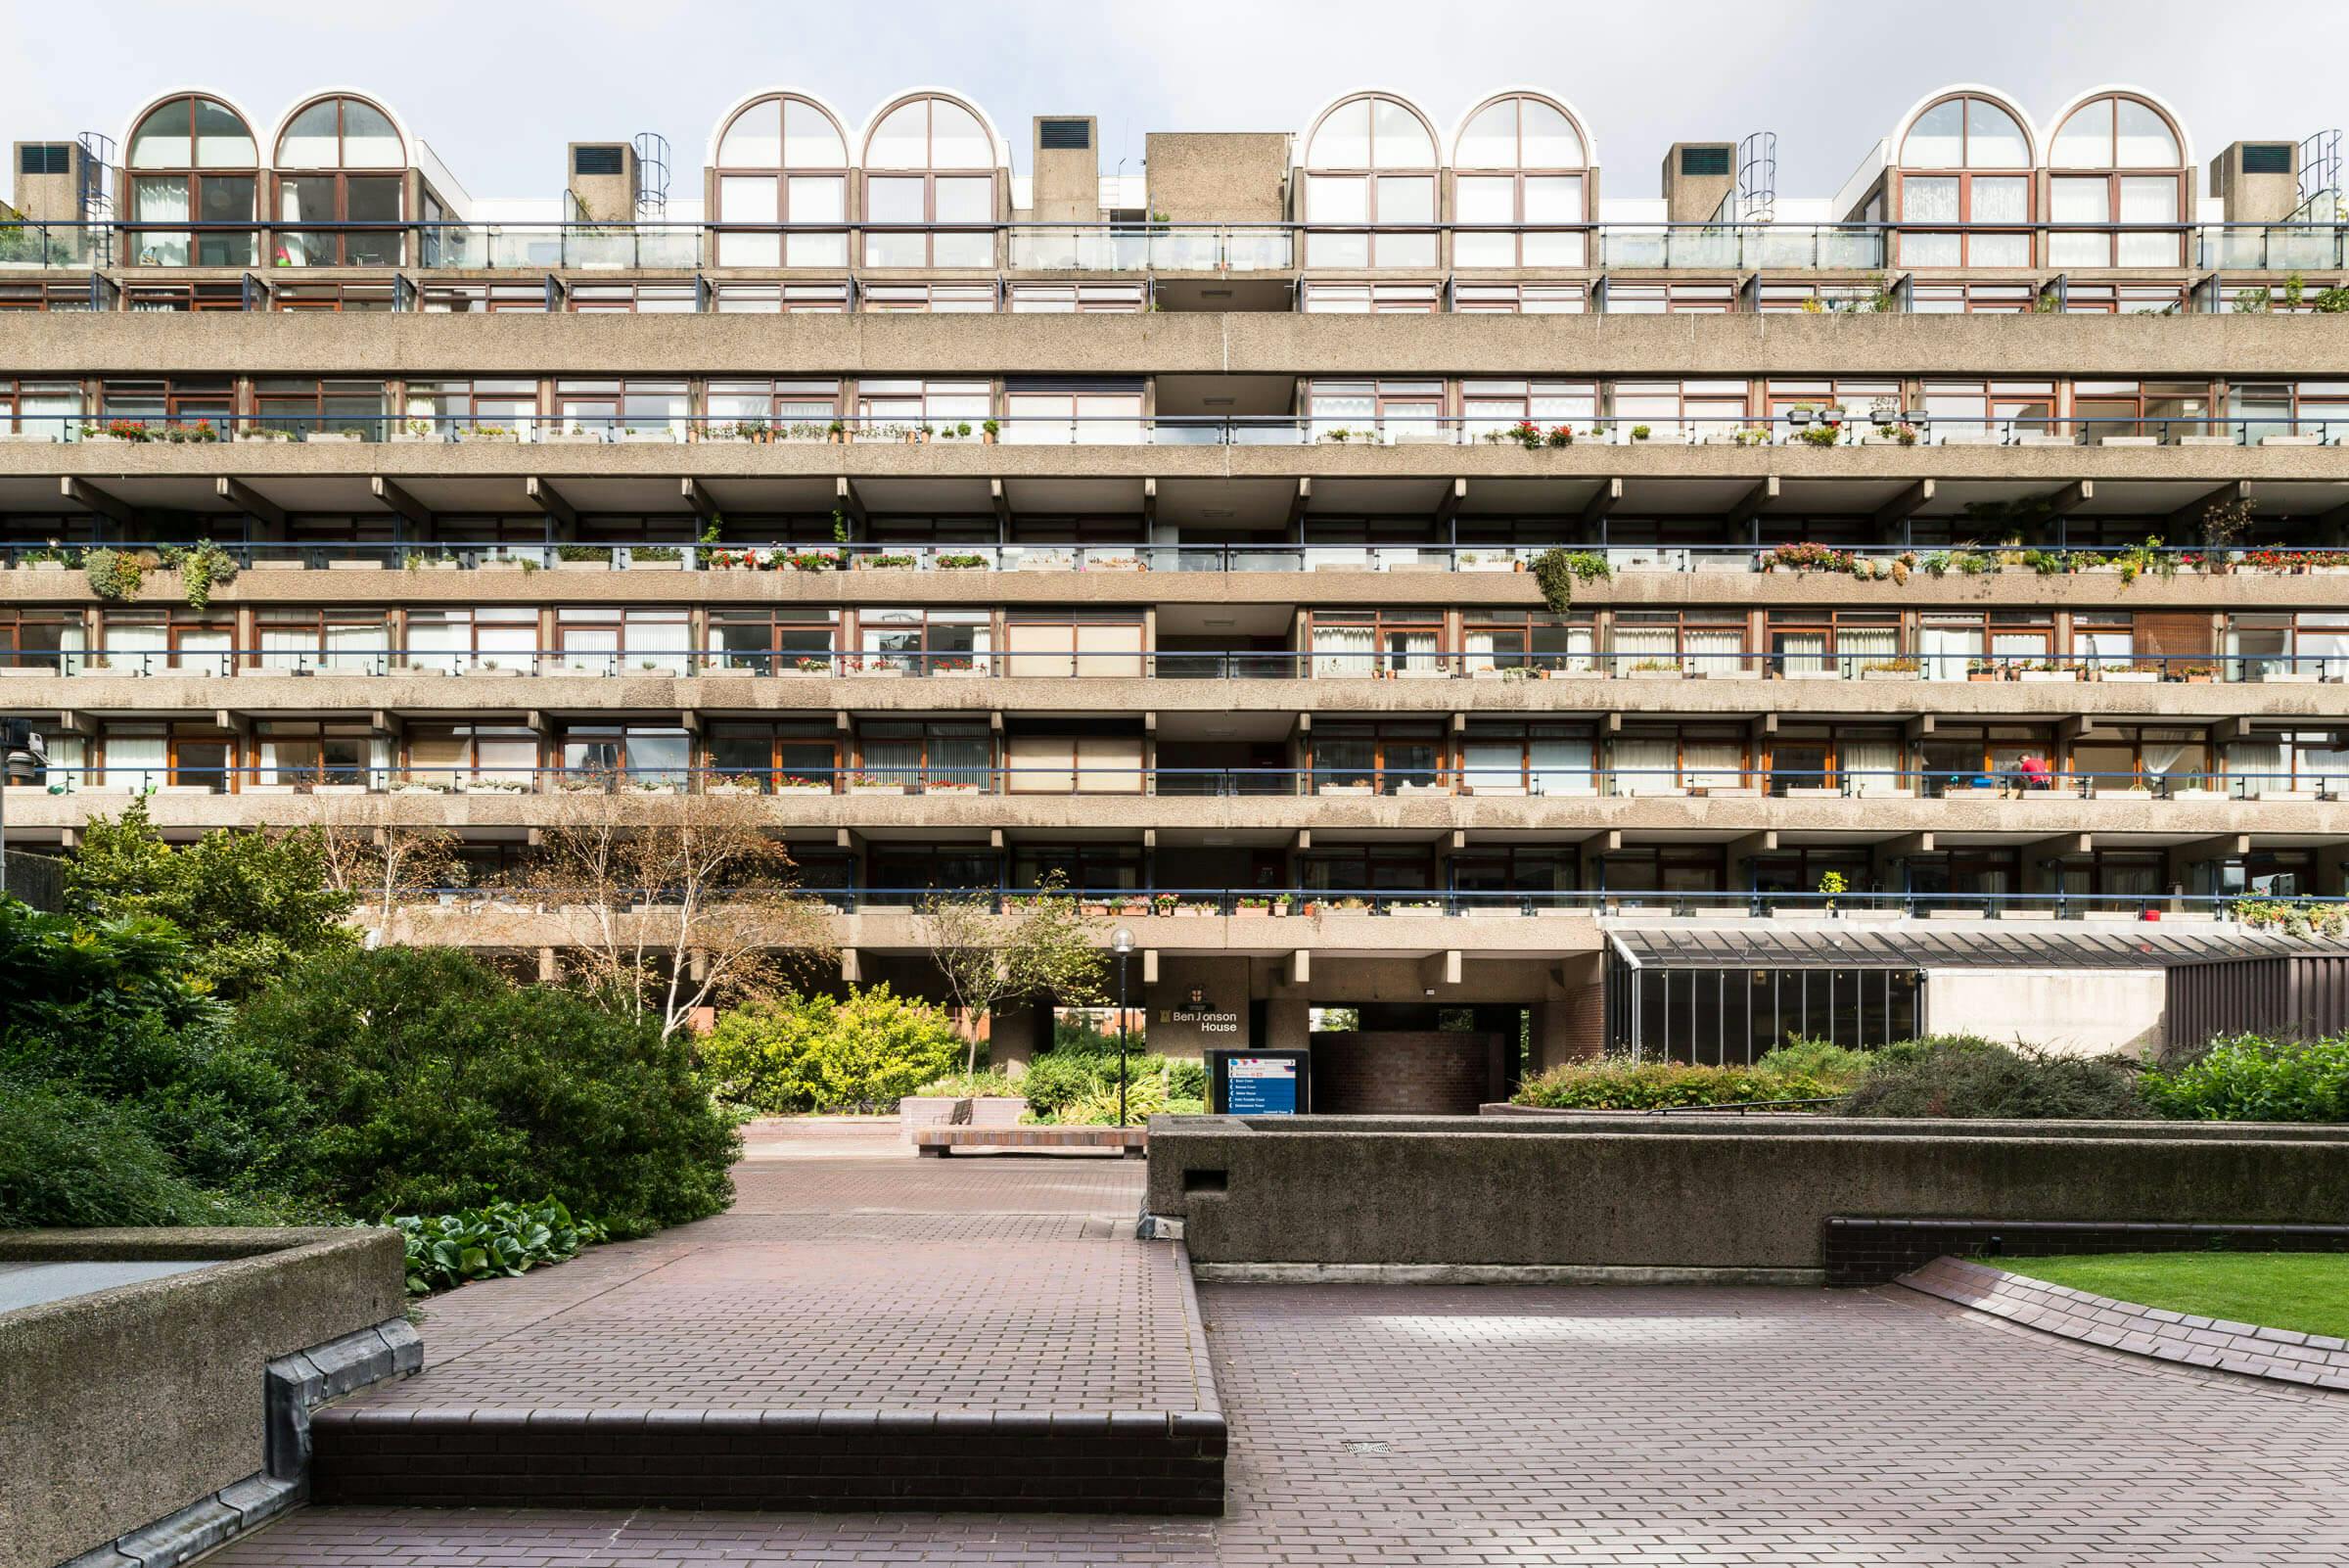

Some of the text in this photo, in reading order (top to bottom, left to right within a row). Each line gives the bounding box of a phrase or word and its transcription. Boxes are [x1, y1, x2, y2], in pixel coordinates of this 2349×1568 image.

[1174, 1012, 1236, 1022] Ben Jonson
[1201, 1023, 1237, 1032] House
